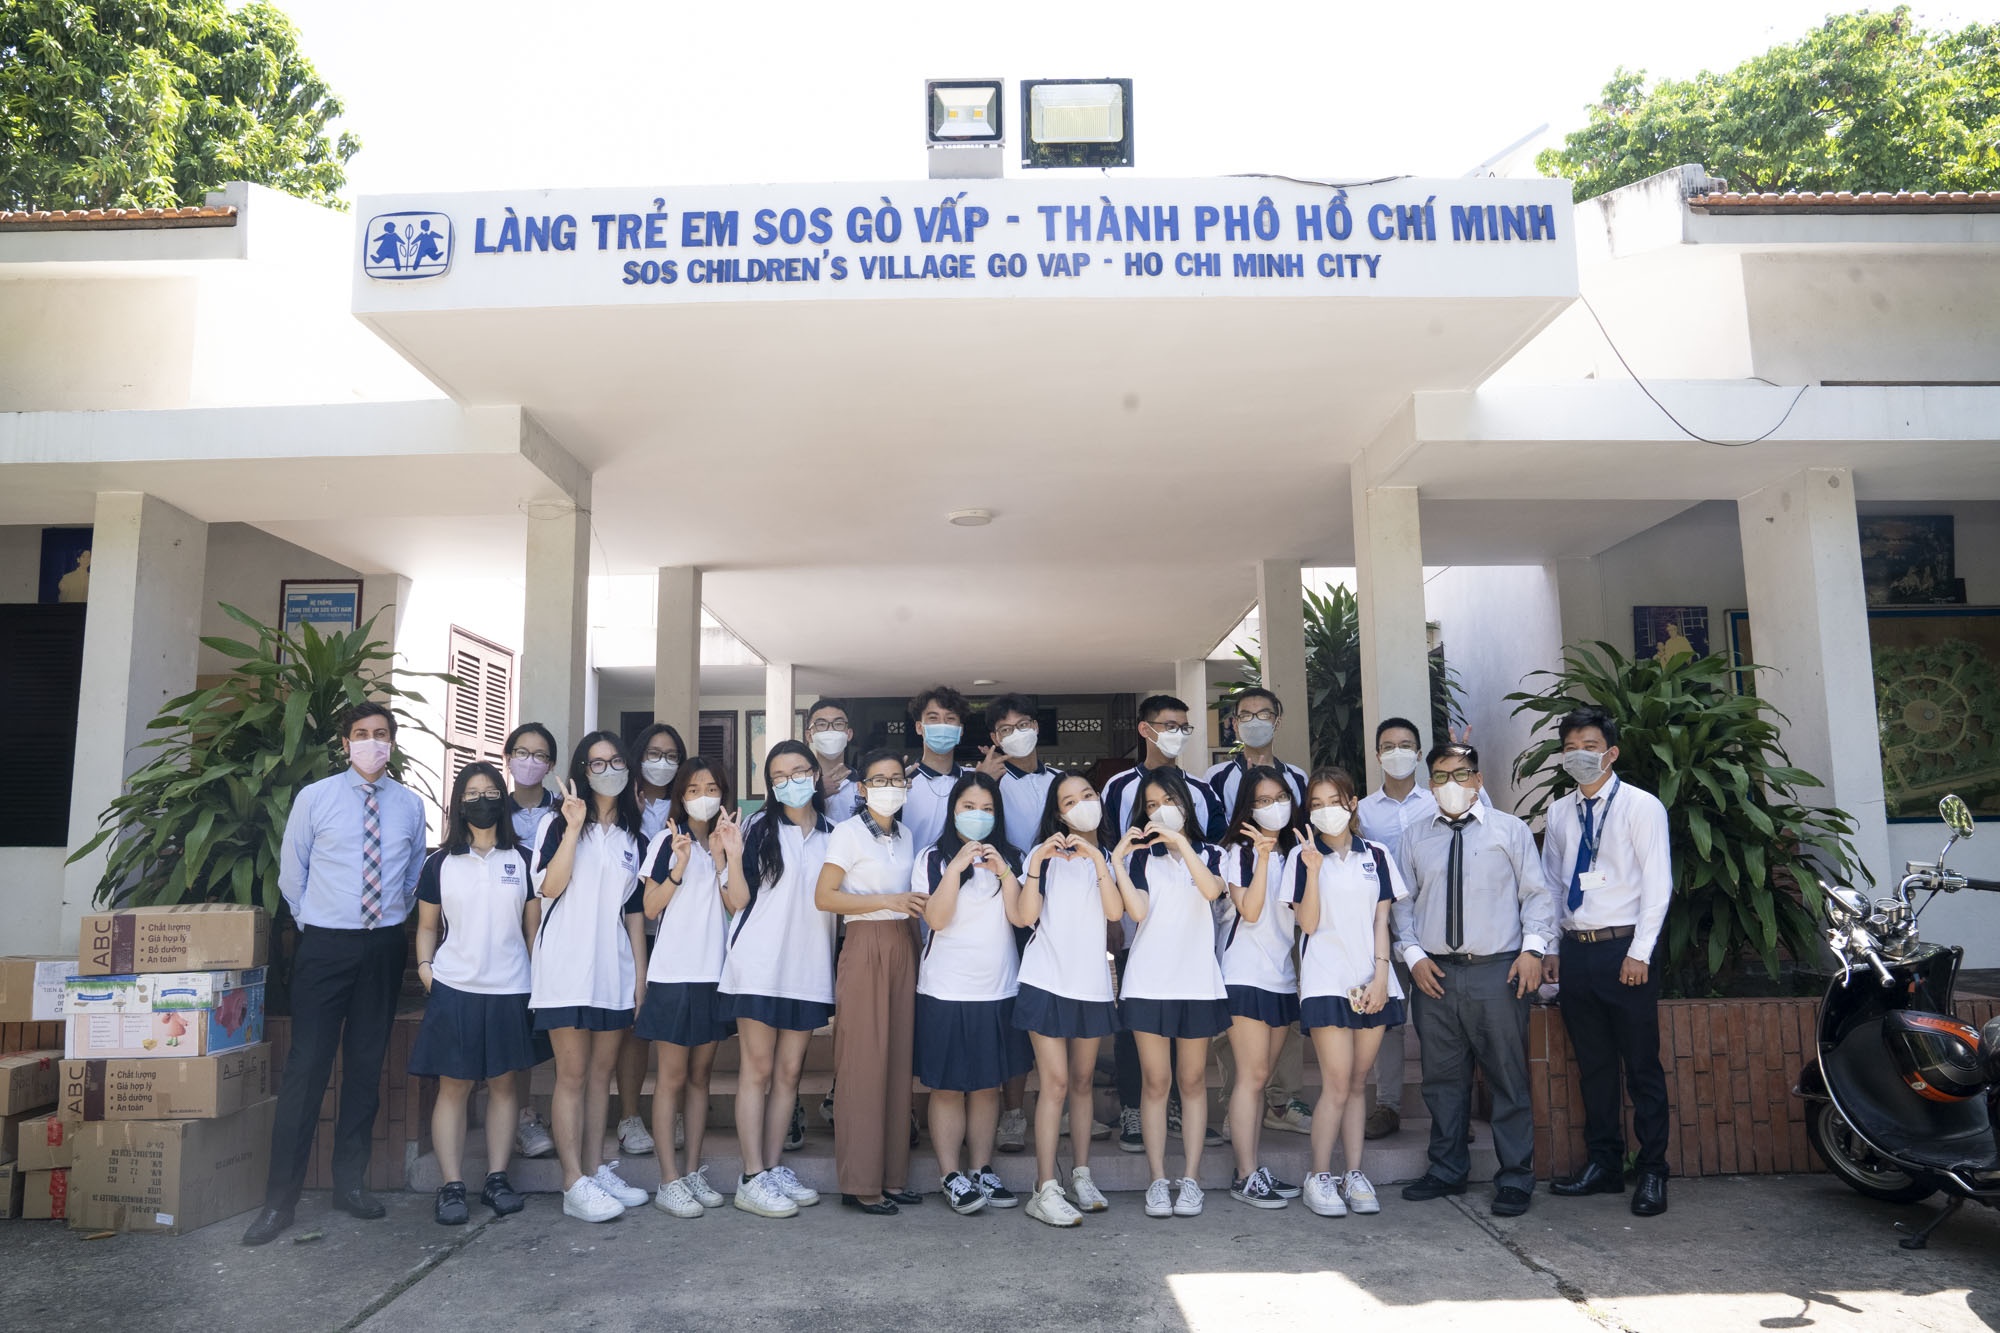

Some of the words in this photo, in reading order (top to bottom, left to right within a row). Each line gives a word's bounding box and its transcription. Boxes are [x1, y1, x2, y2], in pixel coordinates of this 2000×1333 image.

[475, 207, 577, 253] LÀNG
[592, 198, 668, 250] TRẺ
[682, 211, 738, 247] EM
[753, 206, 832, 246] SOS
[846, 196, 902, 243] GÒ
[914, 191, 989, 243] VẤP
[1038, 196, 1179, 241] THÀNH
[1296, 190, 1353, 241] HỒ
[1368, 195, 1437, 241] CHÍ
[1451, 204, 1556, 241] MINH
[622, 259, 678, 285] SOS
[687, 249, 848, 284] CHILDREN'S
[859, 254, 976, 280] VILLAGE
[988, 253, 1027, 278] GO
[1037, 252, 1091, 277] VAP
[1125, 252, 1163, 276] HO
[1175, 252, 1221, 277] CHI
[1233, 253, 1304, 277] MINH
[1317, 253, 1382, 278] CITY
[93, 920, 111, 967] ABC
[147, 955, 158, 963] An
[68, 1067, 84, 1114] ABC
[117, 1103, 126, 1111] An
